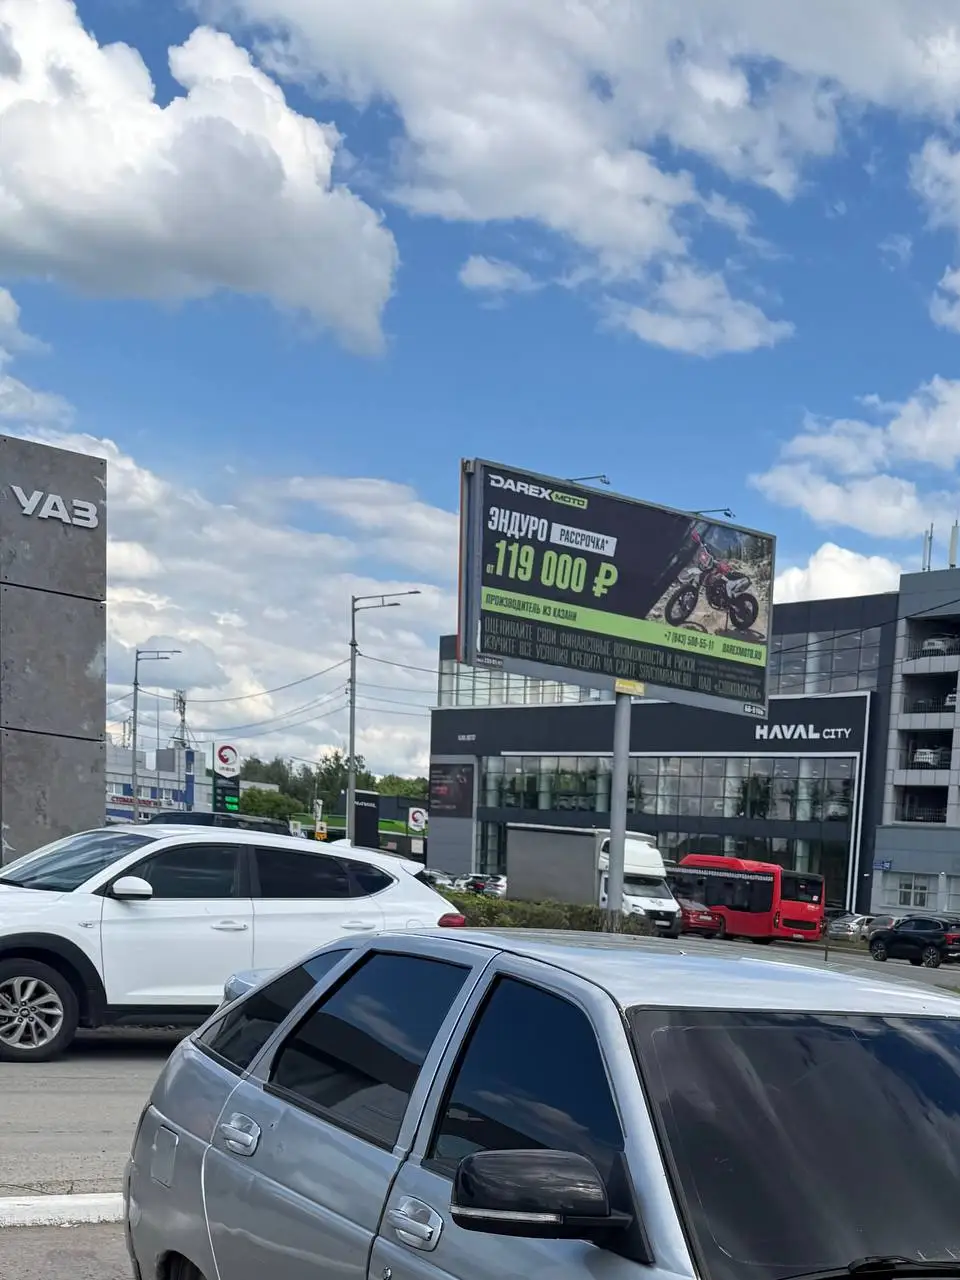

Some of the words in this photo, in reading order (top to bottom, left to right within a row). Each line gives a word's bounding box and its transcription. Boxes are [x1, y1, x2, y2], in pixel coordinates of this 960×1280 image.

[10, 484, 99, 529] УАЗ
[488, 474, 552, 501] DAREX
[555, 493, 586, 507] MOTO
[488, 506, 549, 542] ЭНДУРО
[495, 540, 535, 582] 119
[540, 550, 587, 593] 000
[486, 593, 541, 615] ПРОИЗВОДИТЕЛЬ
[755, 724, 820, 739] HAVAL
[822, 728, 852, 739] CITY
